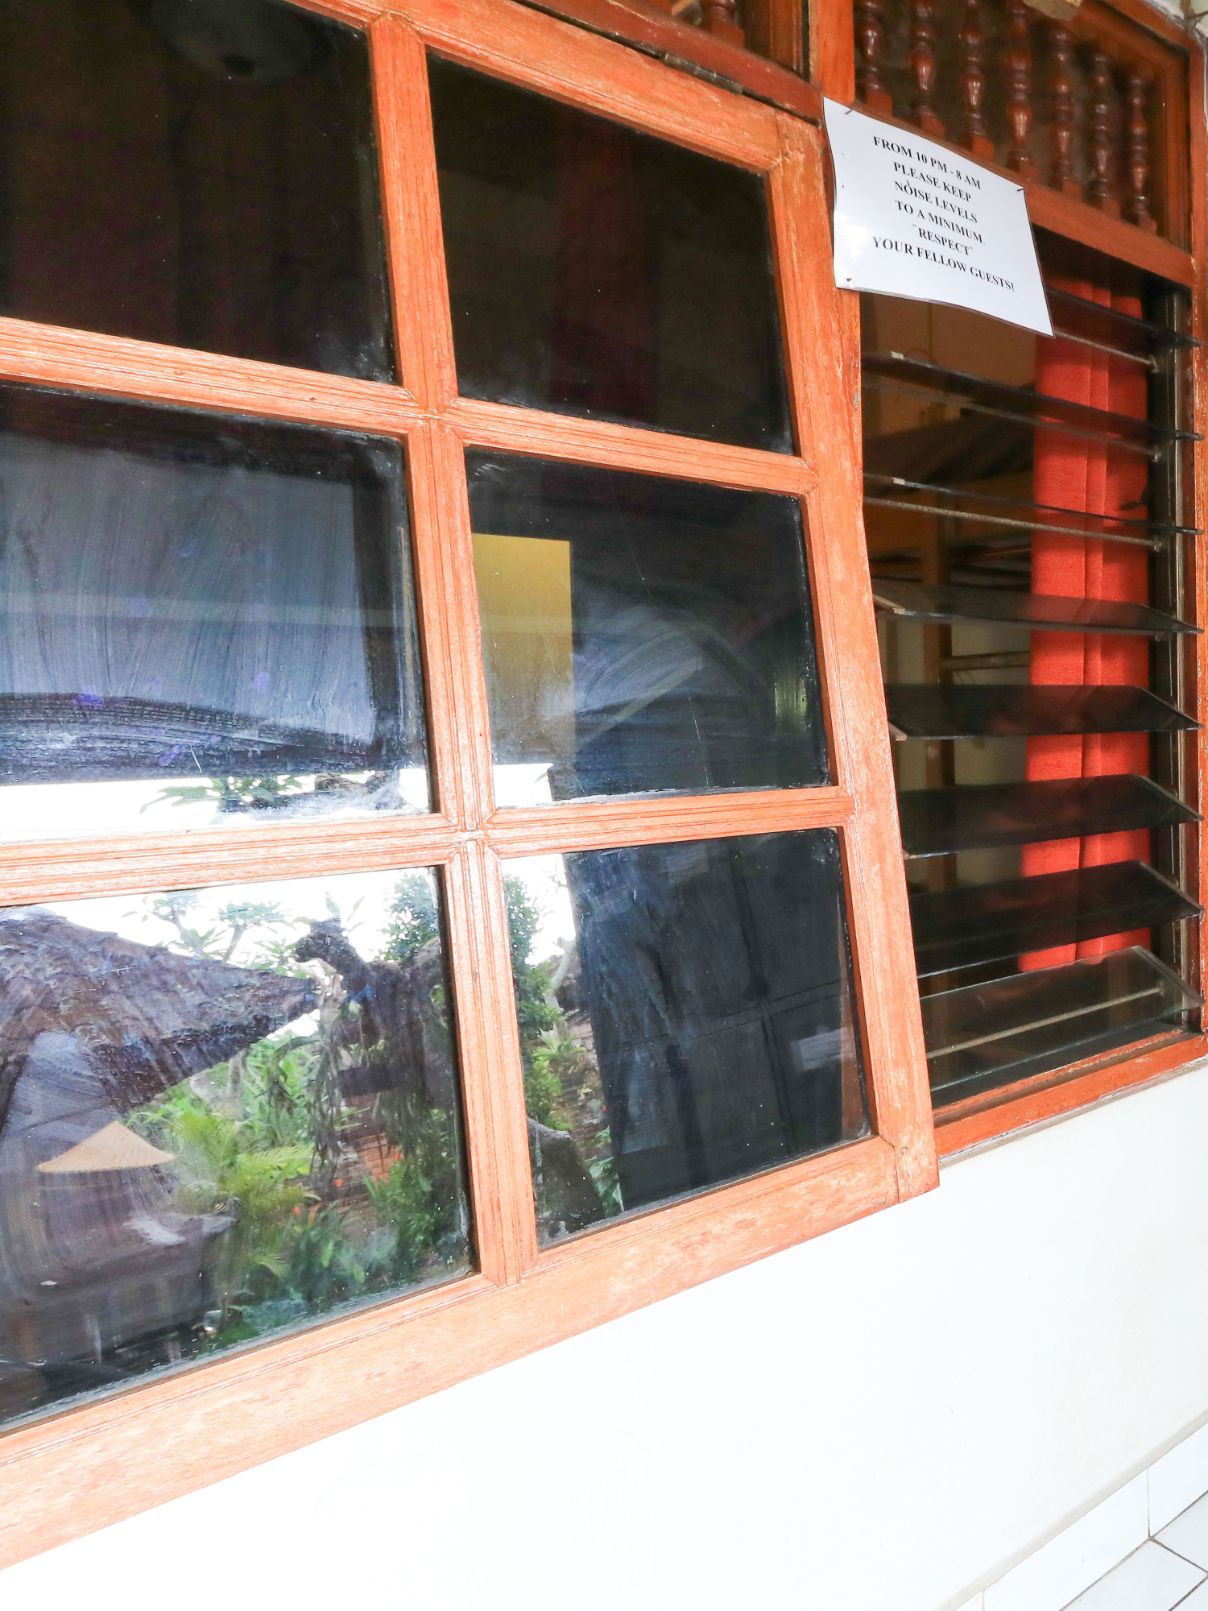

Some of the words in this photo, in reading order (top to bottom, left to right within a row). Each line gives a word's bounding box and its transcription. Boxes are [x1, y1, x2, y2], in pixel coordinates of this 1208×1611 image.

[873, 136, 912, 158] FROM
[916, 152, 927, 164] 10
[931, 159, 947, 173] PM
[956, 170, 962, 180] 8
[965, 175, 981, 189] AM
[894, 162, 940, 188] PLEASE
[943, 184, 971, 202] KEEP
[894, 181, 932, 204] NOISE
[936, 197, 977, 223] LEVELS
[895, 200, 913, 215] TO
[918, 210, 925, 219] A
[929, 212, 983, 243] MINIMUM
[873, 237, 913, 255] YOUR
[917, 247, 967, 272] FELLOW
[970, 267, 1014, 292] GUESTS!
